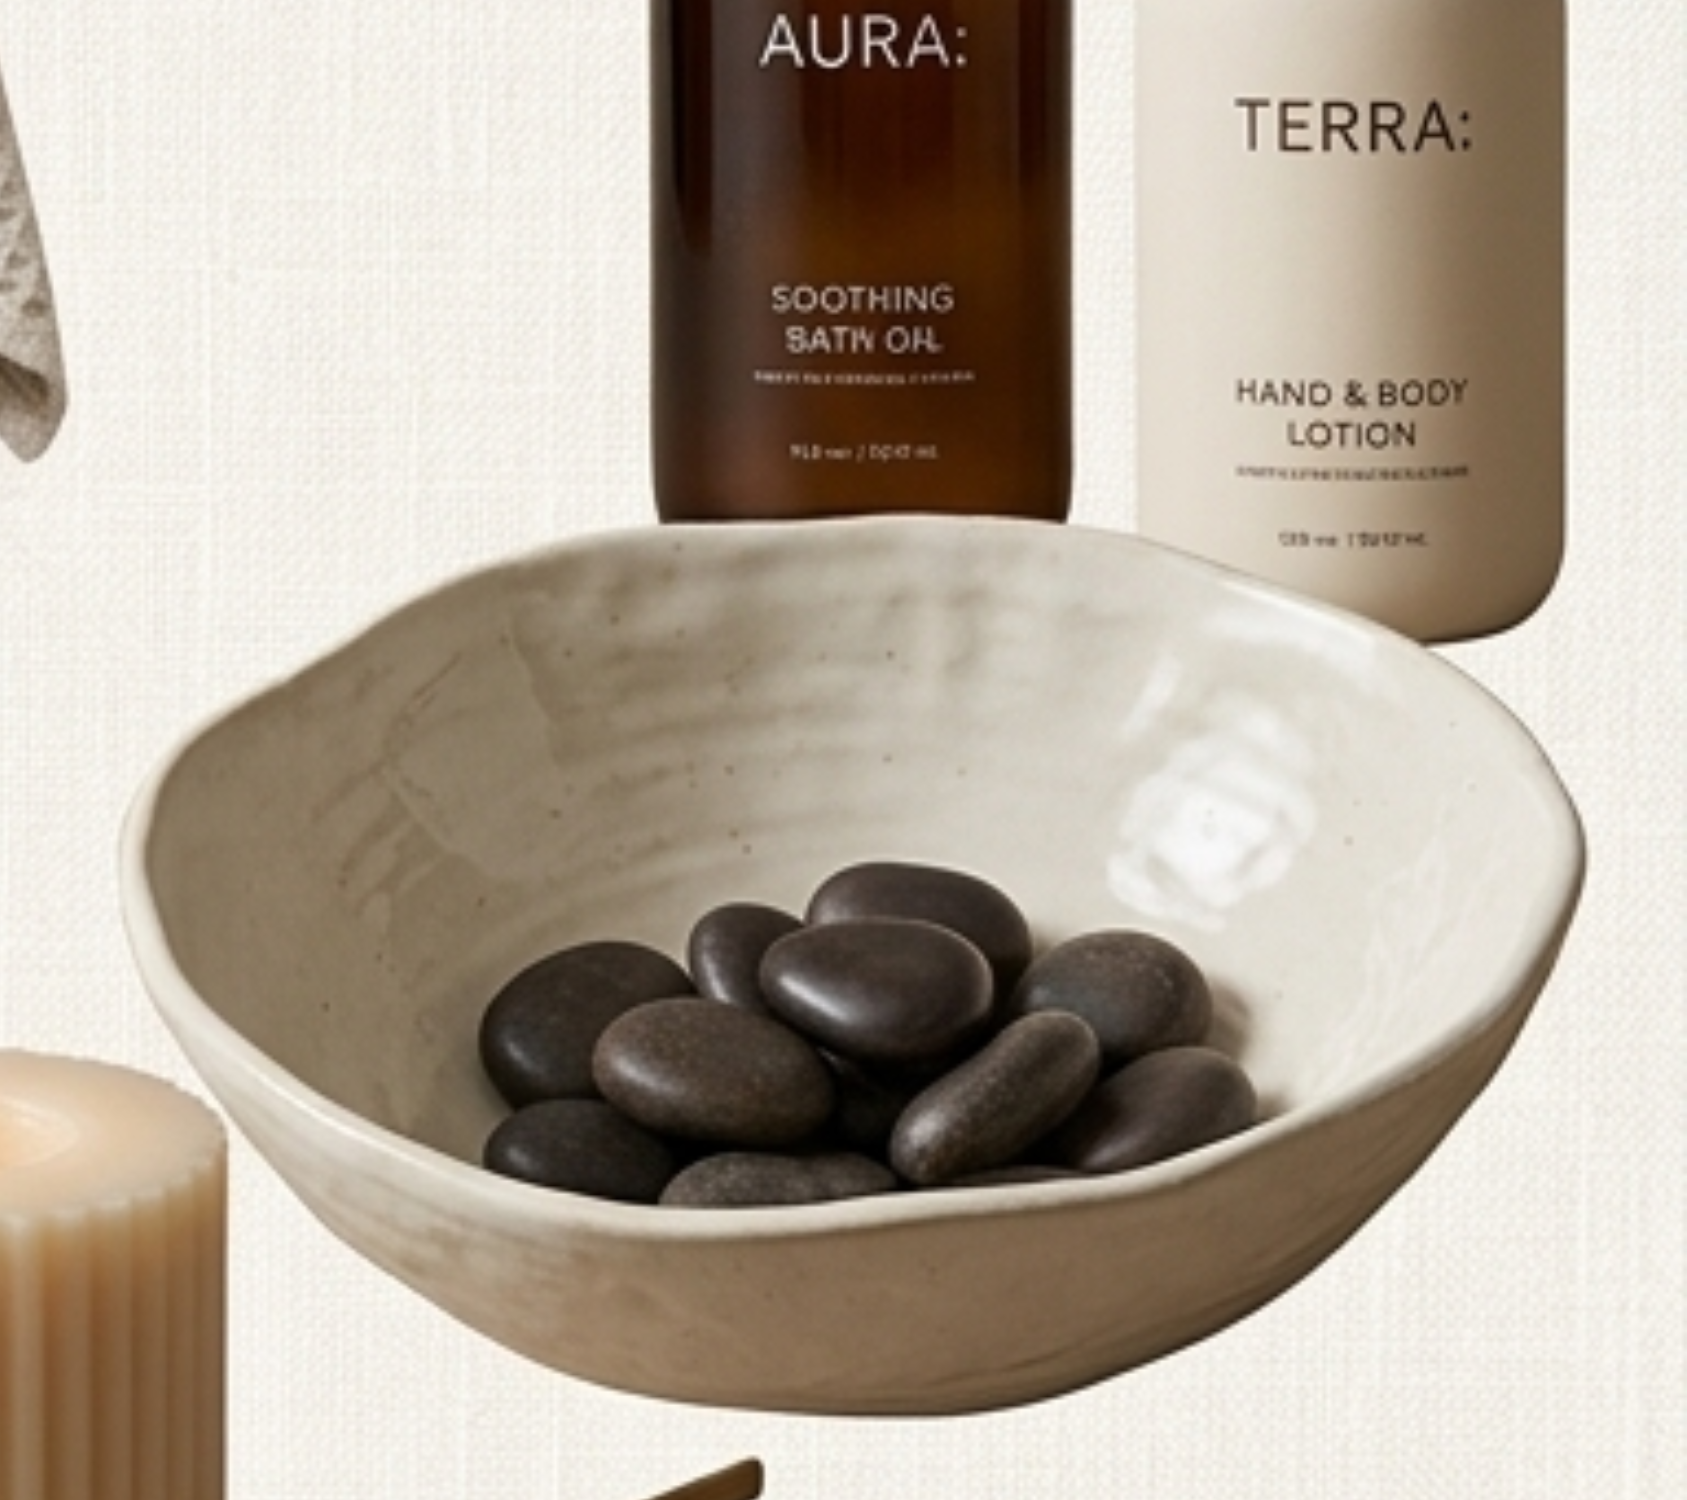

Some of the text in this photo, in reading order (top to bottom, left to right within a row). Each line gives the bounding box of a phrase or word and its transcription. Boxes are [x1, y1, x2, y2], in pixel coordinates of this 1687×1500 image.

[759, 13, 968, 69] AURA:
[1235, 98, 1472, 153] TERRA:
[770, 284, 955, 315] SOOTHING
[1236, 378, 1469, 407] HAND & BODY
[1288, 421, 1417, 449] LOTION
